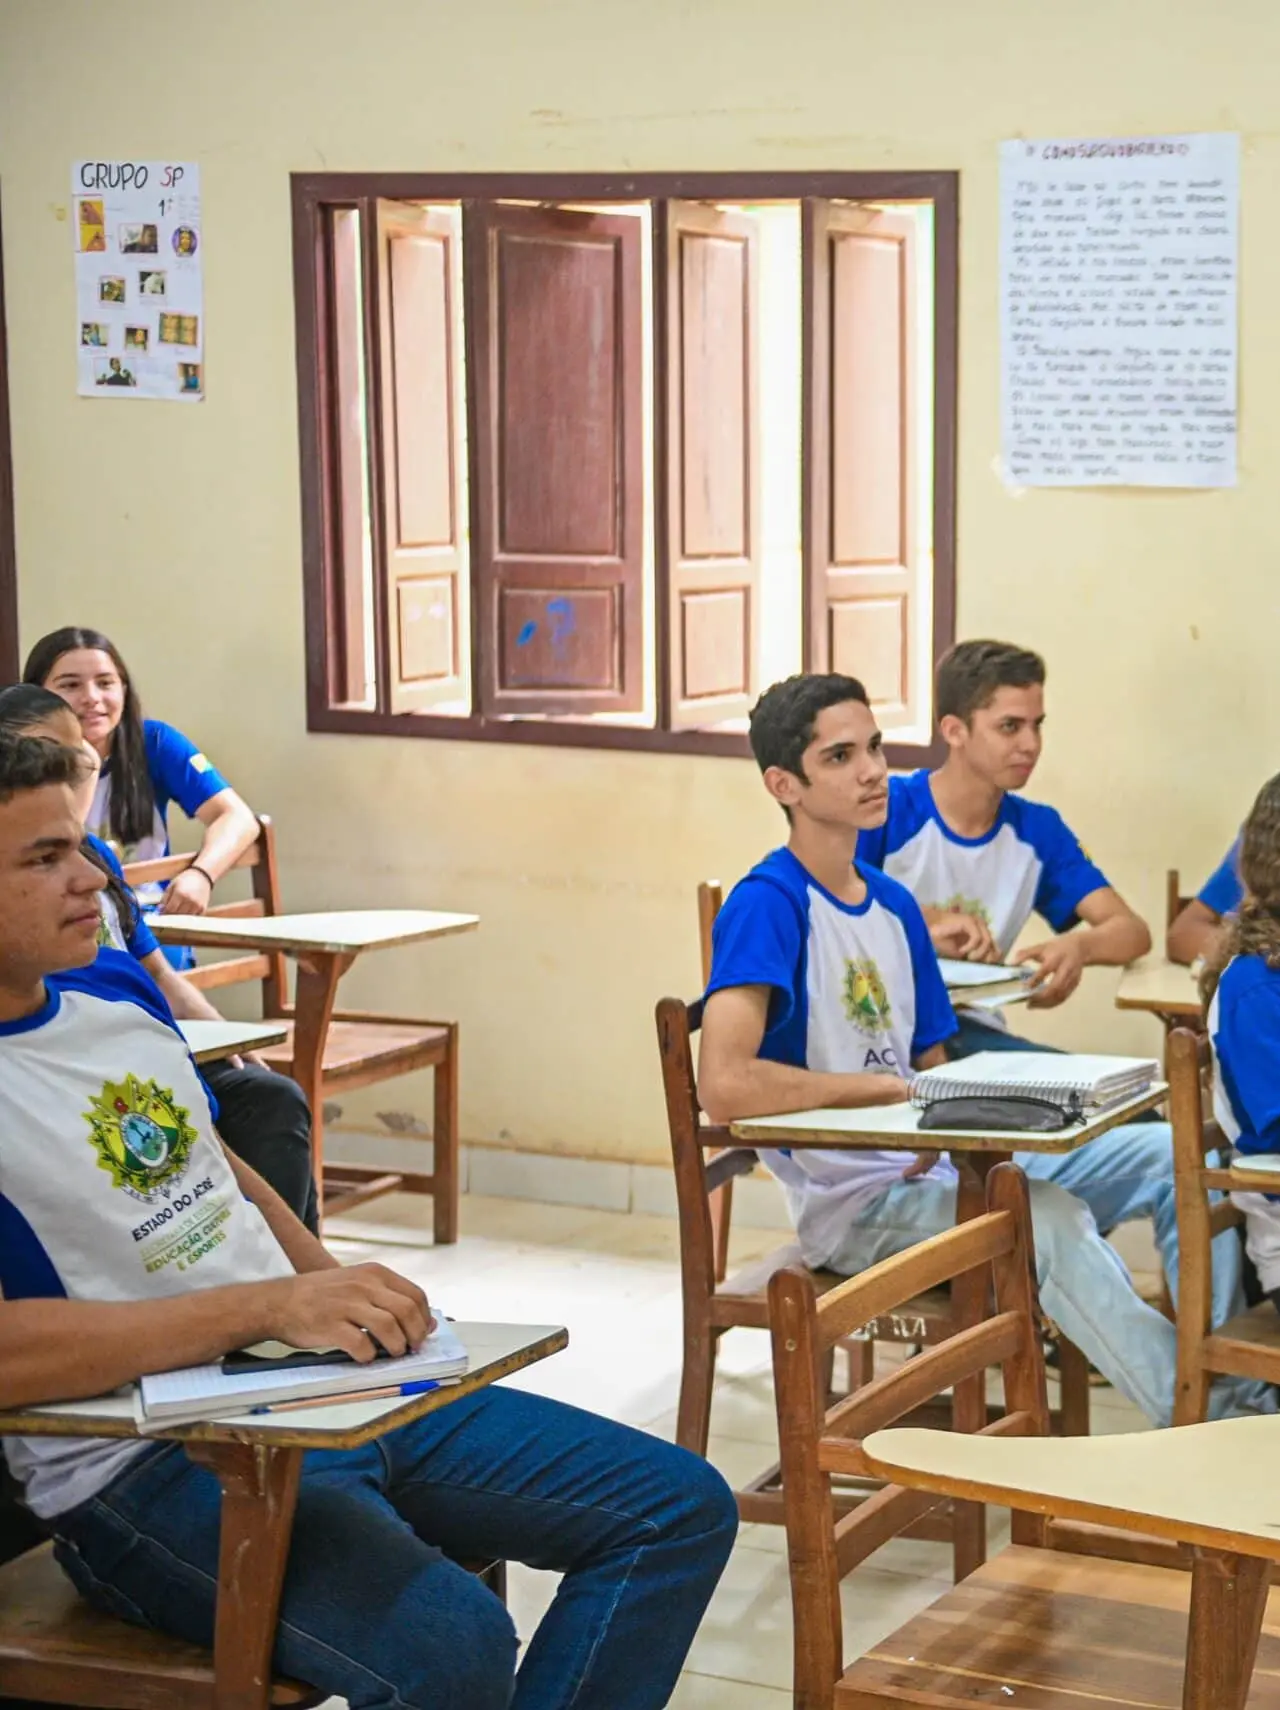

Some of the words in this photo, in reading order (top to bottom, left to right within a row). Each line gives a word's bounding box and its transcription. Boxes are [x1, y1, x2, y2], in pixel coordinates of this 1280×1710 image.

[80, 162, 148, 190] GRUPO
[160, 166, 184, 187] SP
[131, 1207, 174, 1242] ESTADO
[172, 1194, 192, 1212] DO
[192, 1177, 214, 1199] ACRE
